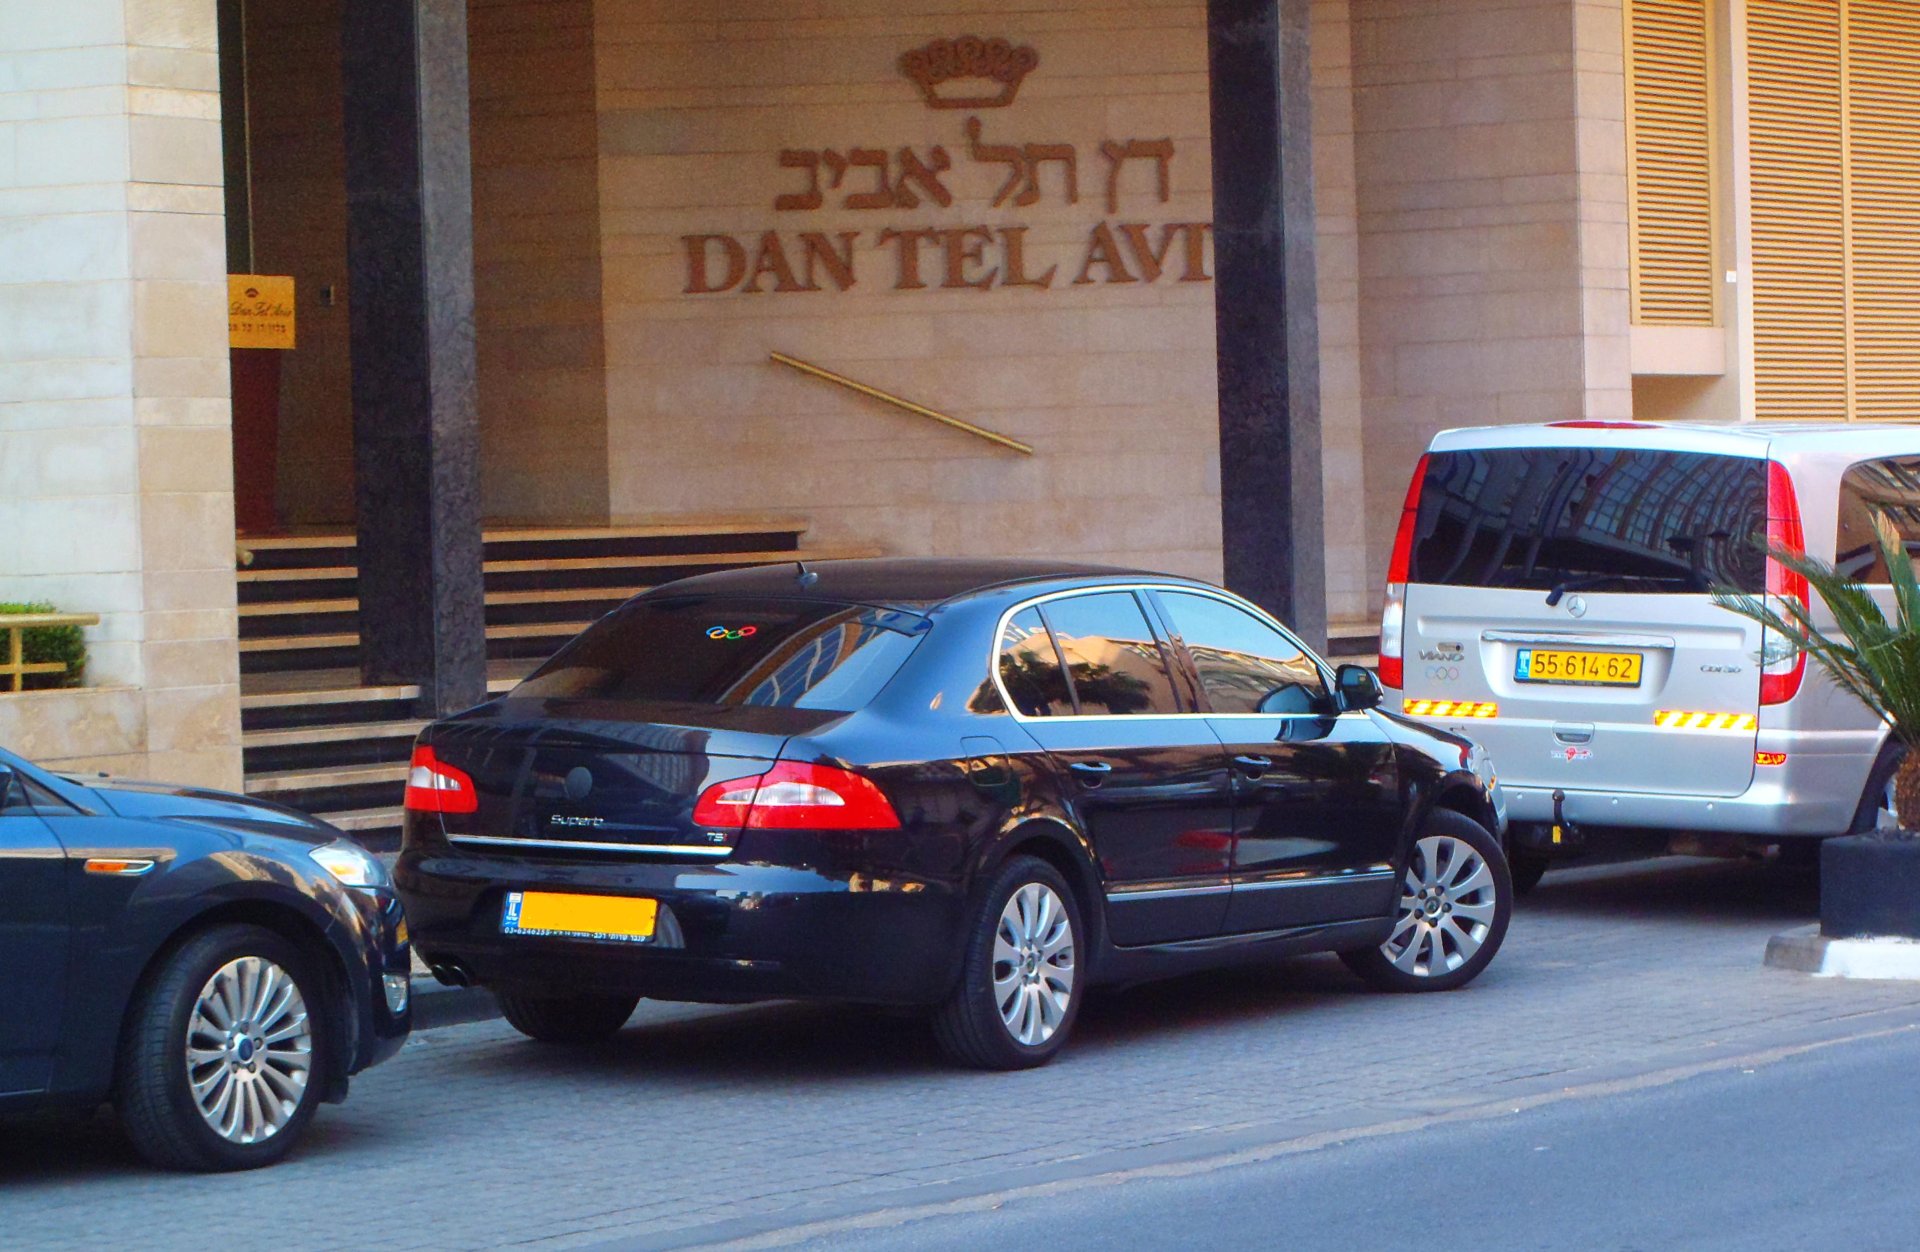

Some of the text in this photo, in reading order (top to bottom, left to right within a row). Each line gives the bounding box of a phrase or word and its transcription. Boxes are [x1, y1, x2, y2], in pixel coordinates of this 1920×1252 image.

[774, 116, 1175, 213] דן תל אביב
[681, 221, 1214, 294] DAN TEL AVI
